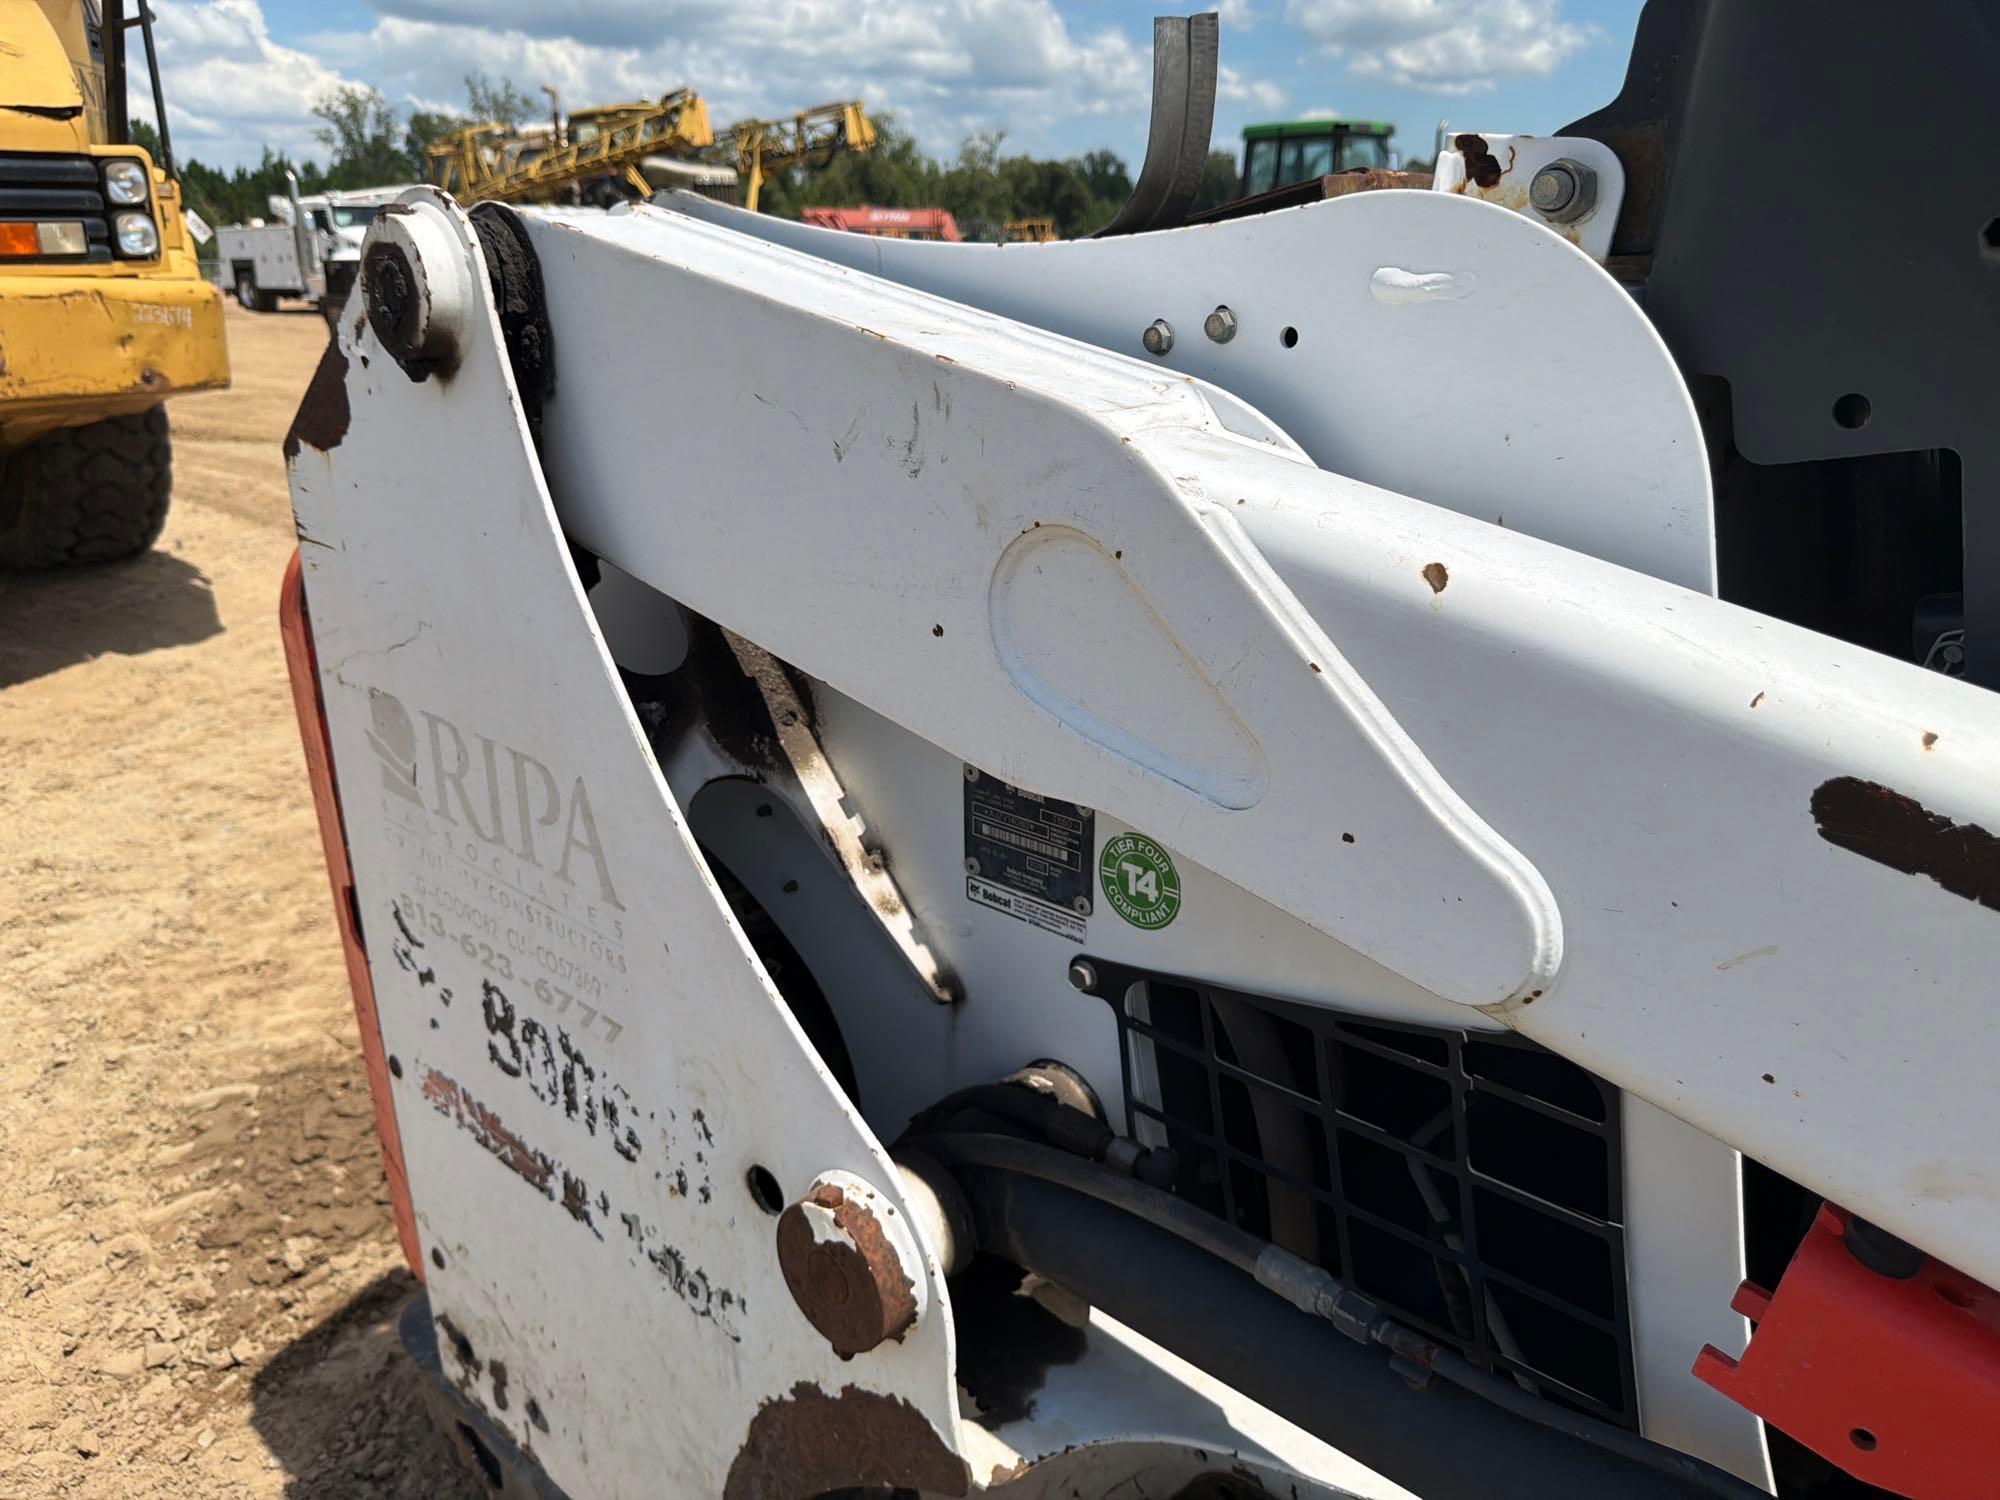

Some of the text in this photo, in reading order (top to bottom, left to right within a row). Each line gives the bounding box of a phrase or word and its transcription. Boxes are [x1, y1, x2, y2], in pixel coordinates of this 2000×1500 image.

[419, 710, 626, 912] RIPA
[1109, 839, 1169, 873] TIER FOUR
[982, 888, 1011, 909] Bobcat
[1108, 885, 1171, 923] COMPLIANT
[1121, 861, 1159, 904] T4
[488, 884, 627, 975] CONSTRUCTORS
[400, 892, 624, 1044] 813-623-6777
